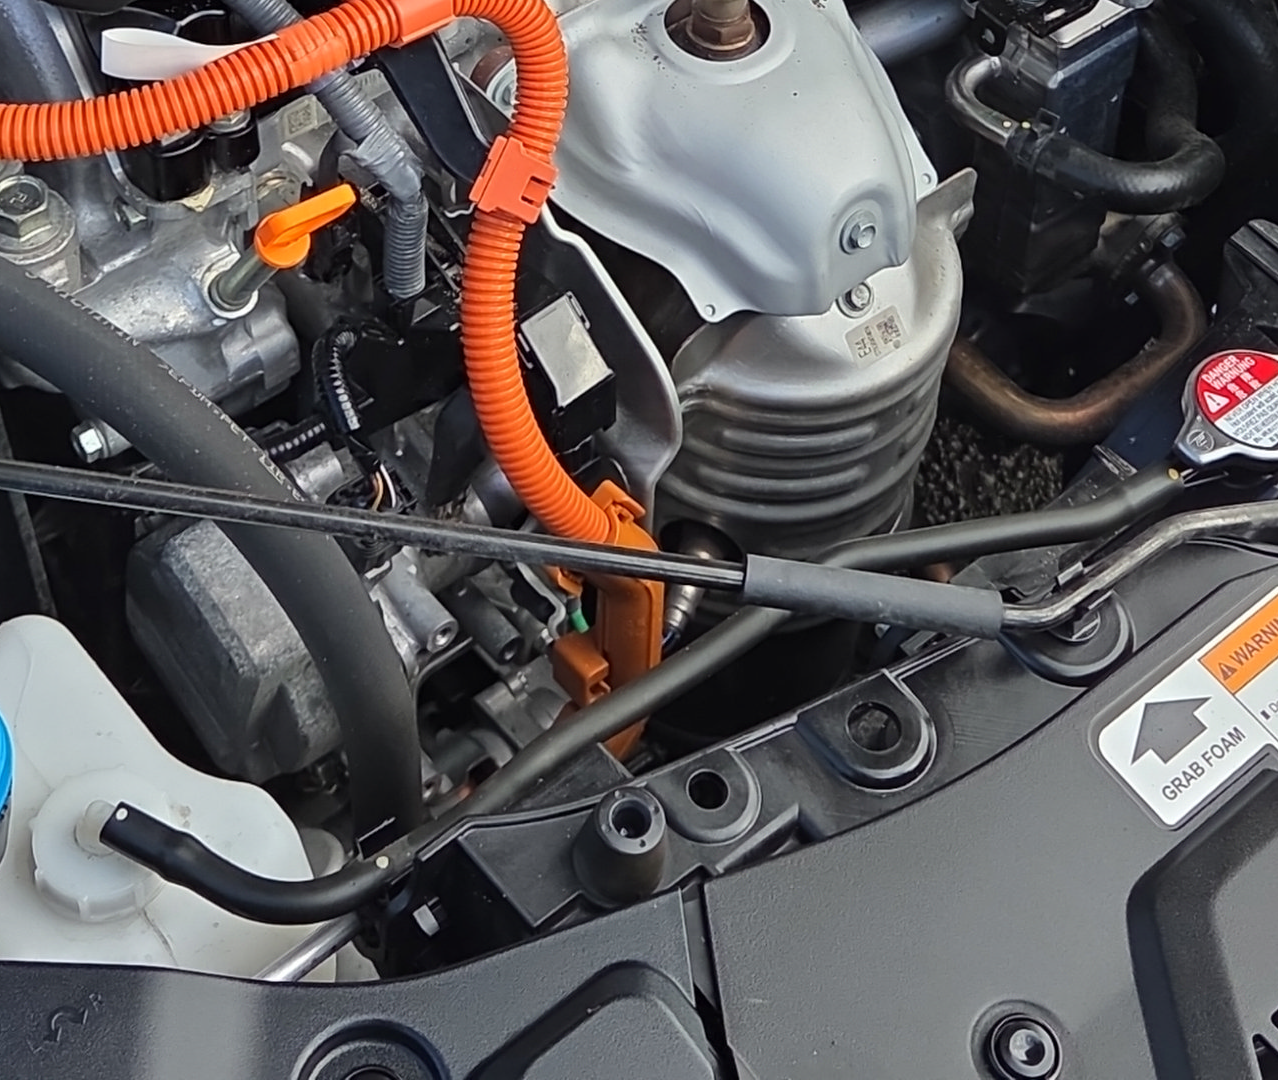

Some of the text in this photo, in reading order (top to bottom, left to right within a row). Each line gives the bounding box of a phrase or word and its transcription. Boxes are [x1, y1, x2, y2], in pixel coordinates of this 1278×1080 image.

[1201, 354, 1240, 384] DANGER
[1210, 356, 1256, 390] WARNUNG
[1162, 726, 1247, 802] GRAB FOAM
